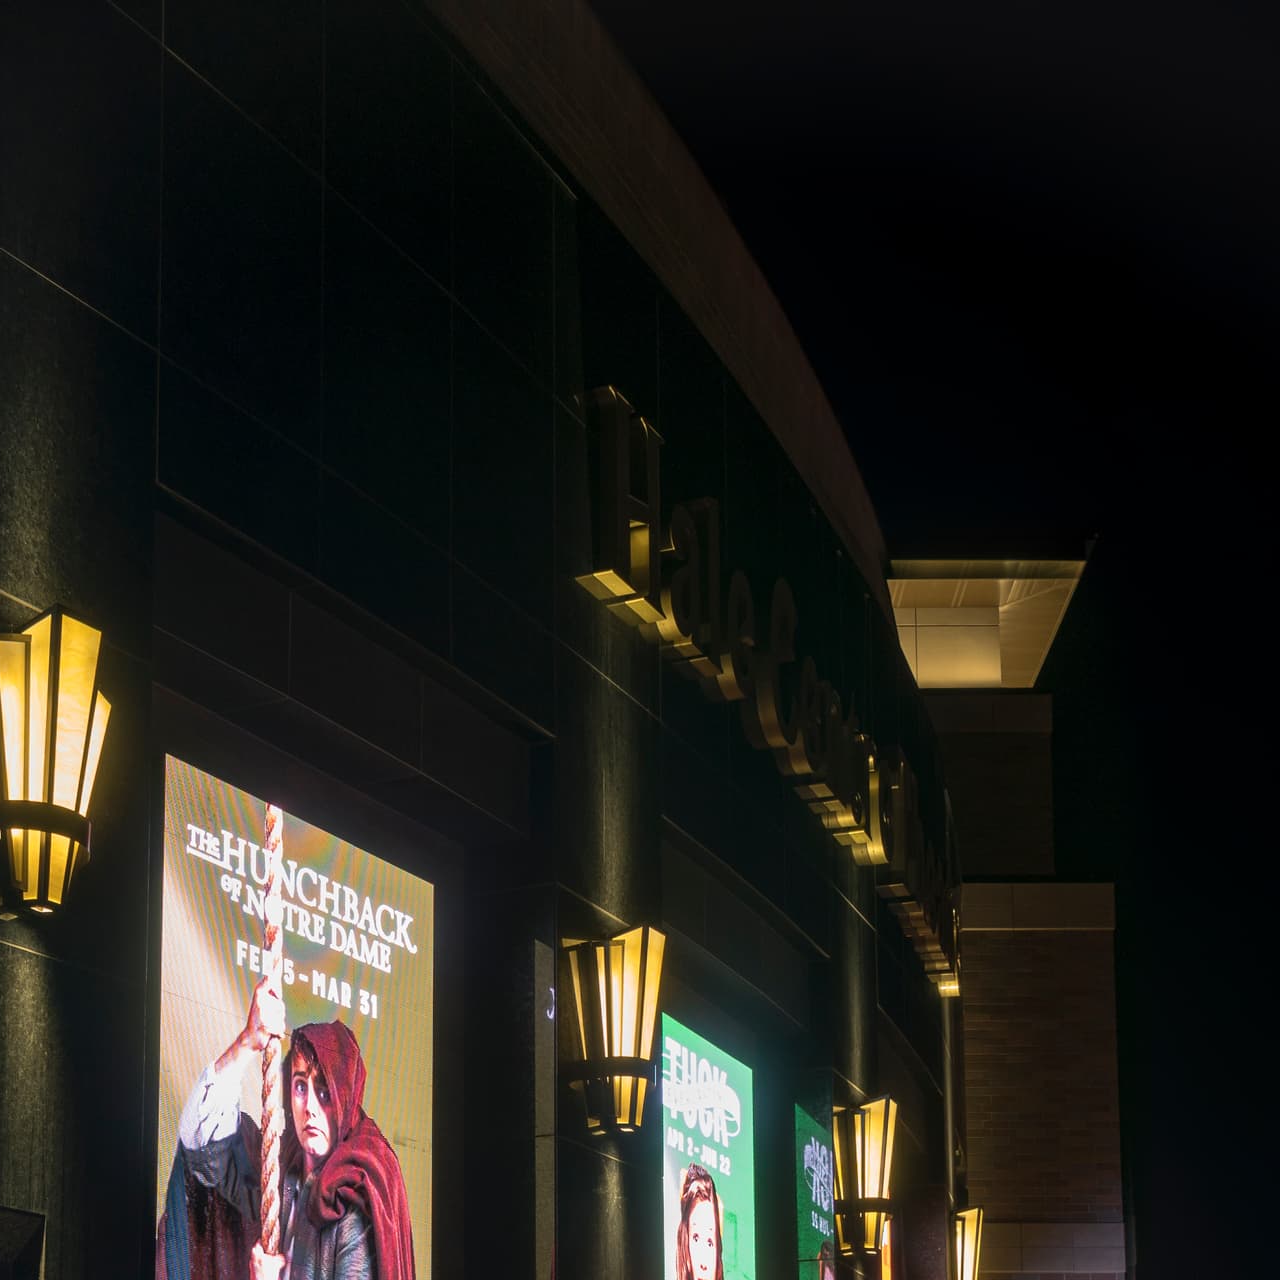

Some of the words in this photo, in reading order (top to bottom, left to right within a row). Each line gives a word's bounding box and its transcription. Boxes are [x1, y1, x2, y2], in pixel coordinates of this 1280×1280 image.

[221, 829, 418, 954] HUNCHBACK
[243, 885, 326, 946] NOTRE
[330, 921, 392, 974] DAME
[359, 988, 378, 1019] 31
